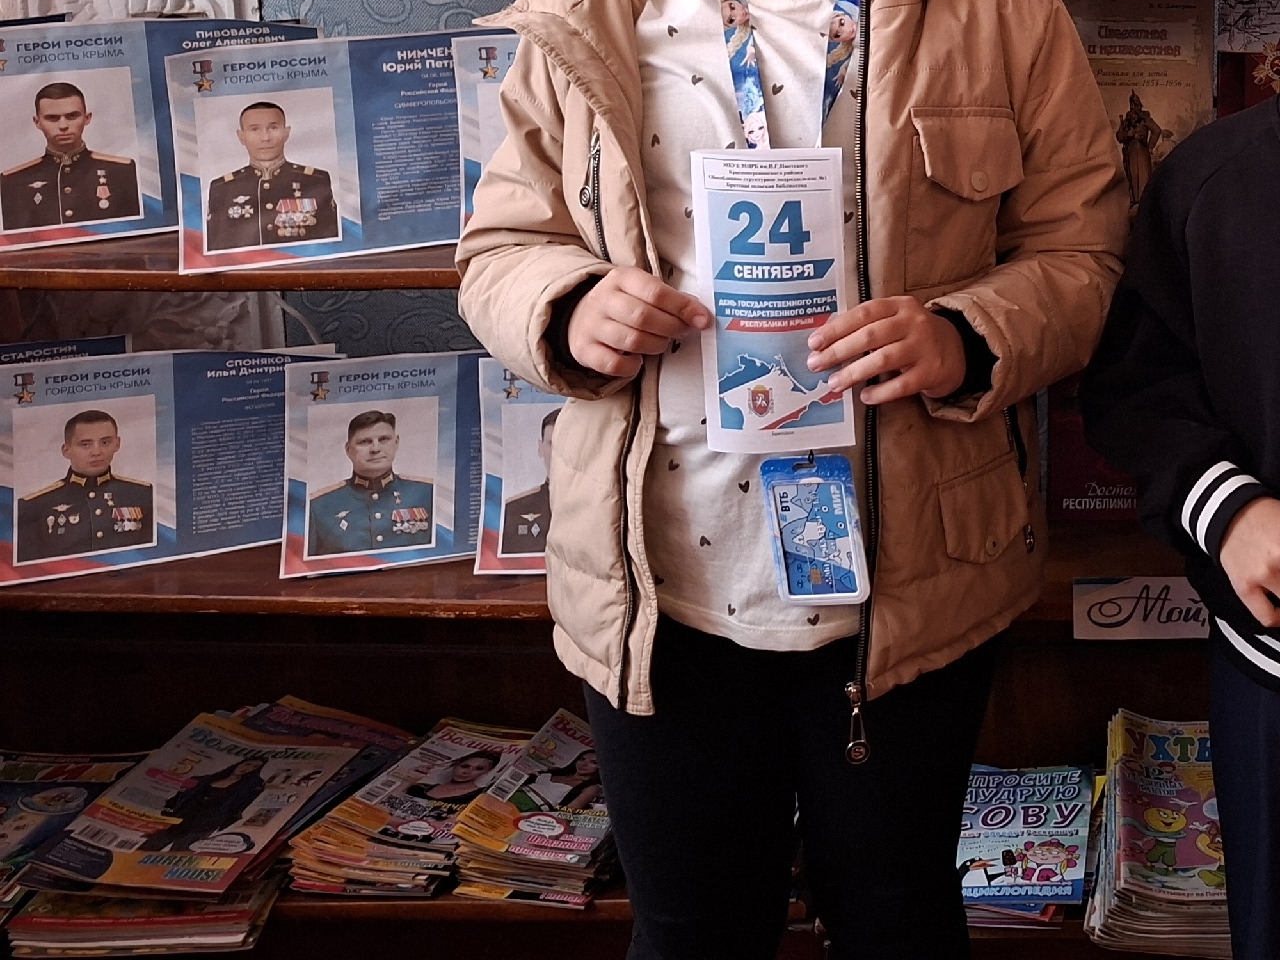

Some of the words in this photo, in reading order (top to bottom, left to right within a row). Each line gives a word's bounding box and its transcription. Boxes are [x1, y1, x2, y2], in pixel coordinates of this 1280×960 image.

[196, 27, 270, 38] ПИВОВАРОВ
[16, 41, 62, 52] ГЕРОИ
[65, 36, 123, 48] РОССИИ
[182, 40, 212, 49] Олег
[18, 52, 79, 64] ГОРДОСТЬ
[83, 48, 124, 60] КРЫМА
[223, 60, 268, 72] ГЕРОИ
[273, 56, 327, 68] РОССИИ
[382, 59, 422, 73] Юрий
[224, 72, 284, 84] ГОРДОСТЬ
[286, 68, 328, 80] КРЫМА
[727, 200, 811, 256] 24
[734, 263, 814, 279] СЕНТЯБРЯ
[738, 298, 812, 308] ГОСУДАРСТВЕННОГО
[813, 296, 837, 304] ГЕРБА
[732, 307, 804, 317] ГОСУДАРСТВЕННОГО
[806, 305, 831, 314] ФЛАГА
[1, 345, 77, 361] СТАРОСТИН
[45, 373, 88, 384] ГЕРОИ
[93, 368, 150, 379] РОССИИ
[339, 372, 379, 382] ГЕРОИ
[383, 368, 436, 379] РОССИИ
[45, 385, 106, 396] ГОРДОСТЬ
[109, 379, 151, 389] КРЫМА
[338, 383, 395, 394] ГОРДОСТЬ
[397, 379, 436, 389] КРЫМА
[779, 492, 790, 512] ВТБ
[831, 485, 843, 515] МИР
[1063, 498, 1131, 509] РЕСПУБЛИКИ
